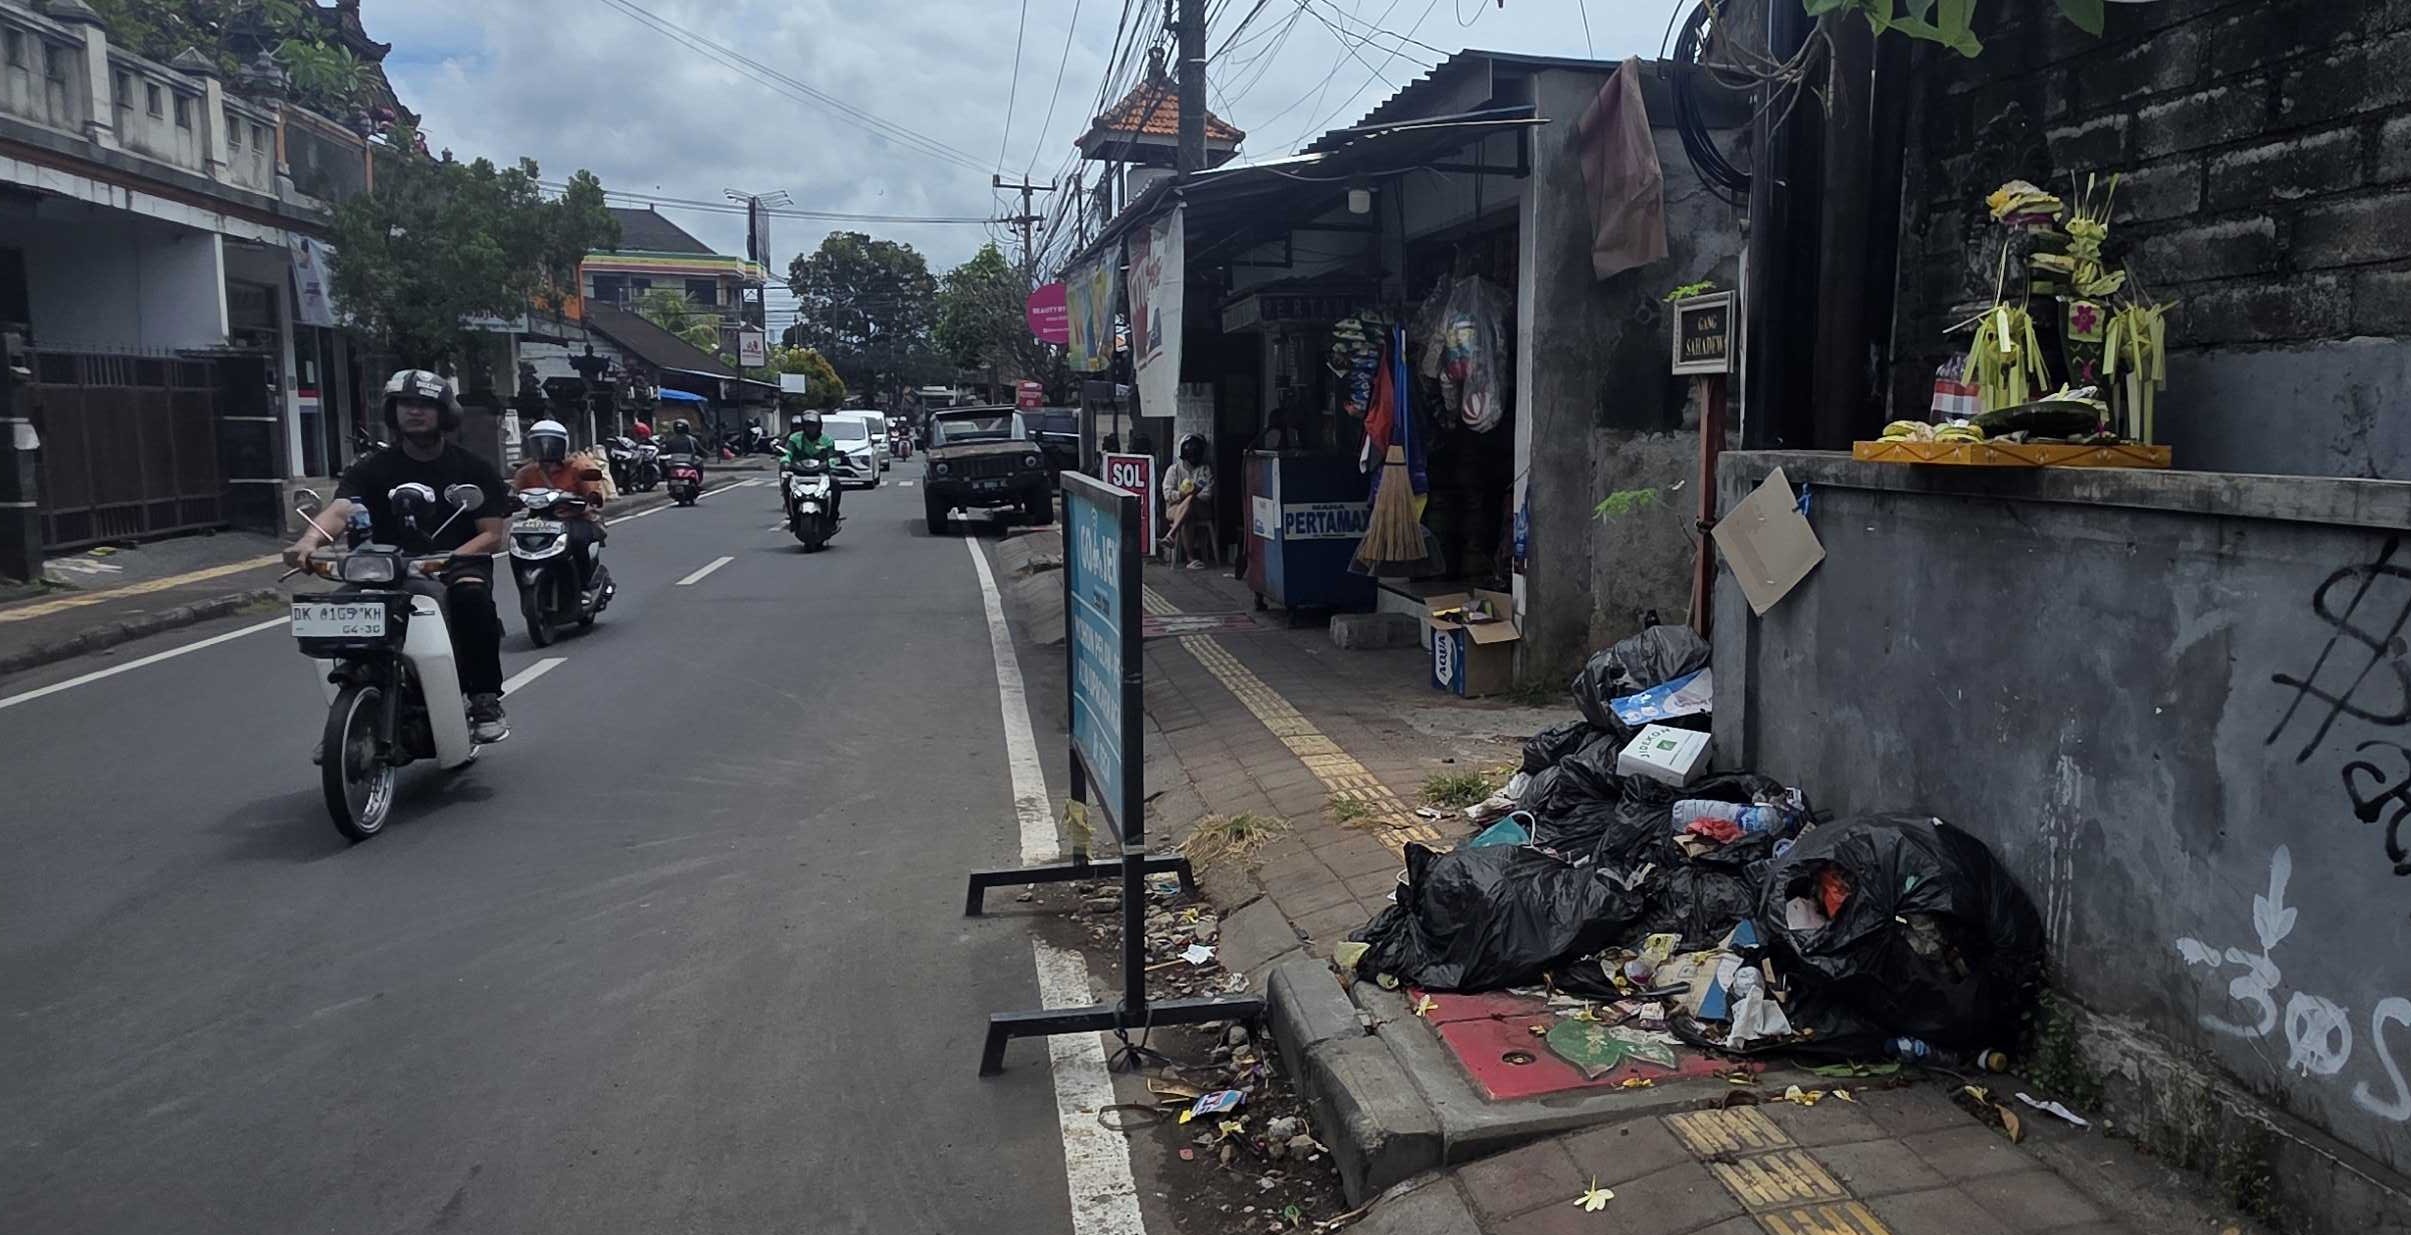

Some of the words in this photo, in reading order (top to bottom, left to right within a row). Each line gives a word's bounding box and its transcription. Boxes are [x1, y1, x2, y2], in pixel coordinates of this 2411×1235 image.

[1697, 314, 1717, 331] GANG
[1685, 335, 1727, 356] SAHADEW
[1112, 462, 1145, 488] SOL
[293, 607, 312, 621] DK
[364, 607, 381, 620] KH
[1438, 635, 1448, 678] AQUA
